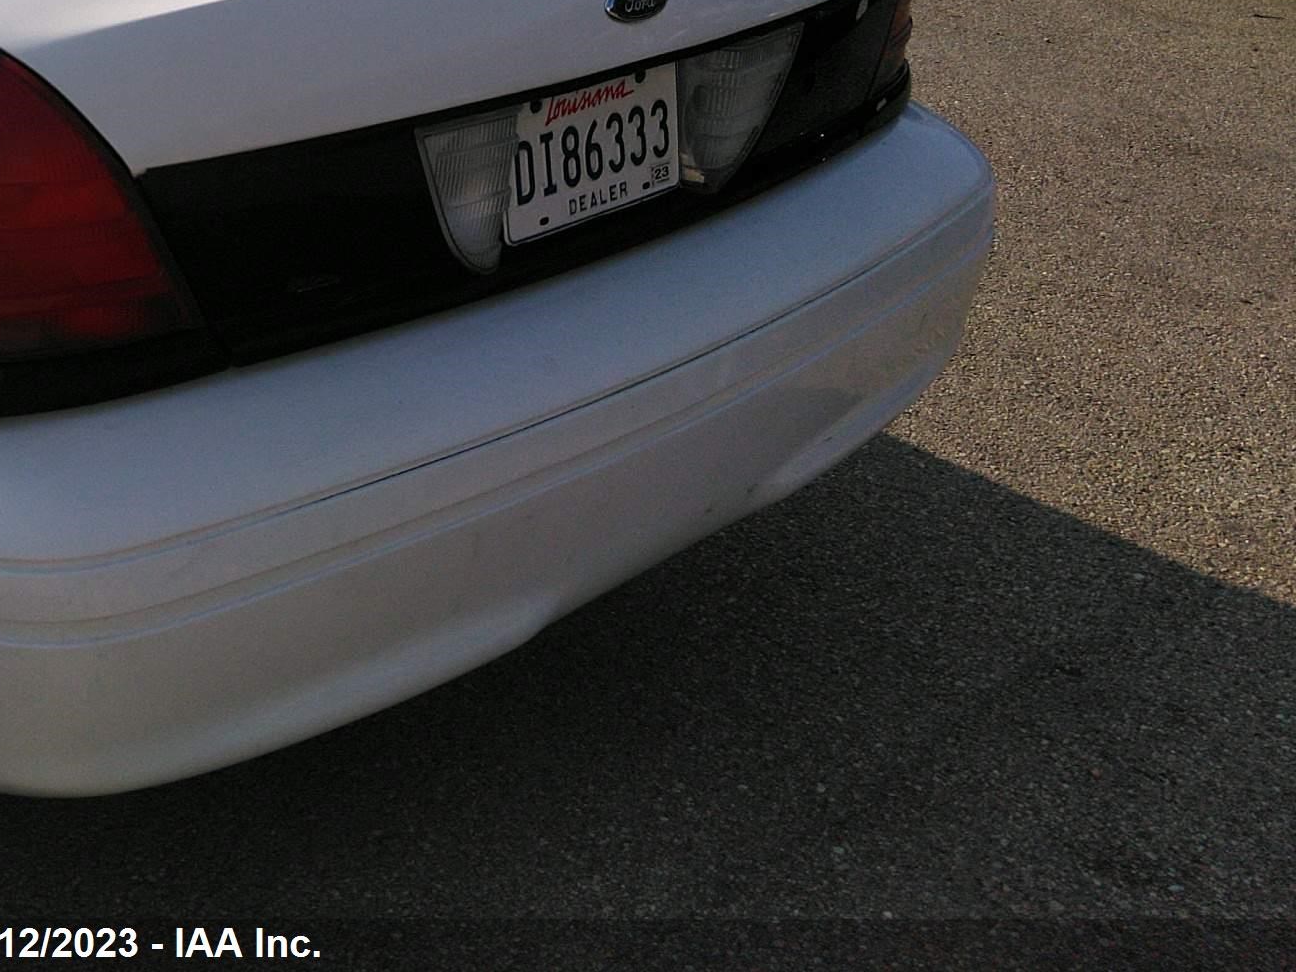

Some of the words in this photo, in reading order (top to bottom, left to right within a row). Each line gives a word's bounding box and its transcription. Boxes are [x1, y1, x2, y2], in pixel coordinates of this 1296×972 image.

[545, 79, 634, 126] Louisiana
[514, 99, 670, 206] DI86333
[654, 166, 669, 180] 23
[569, 181, 629, 215] DEALER
